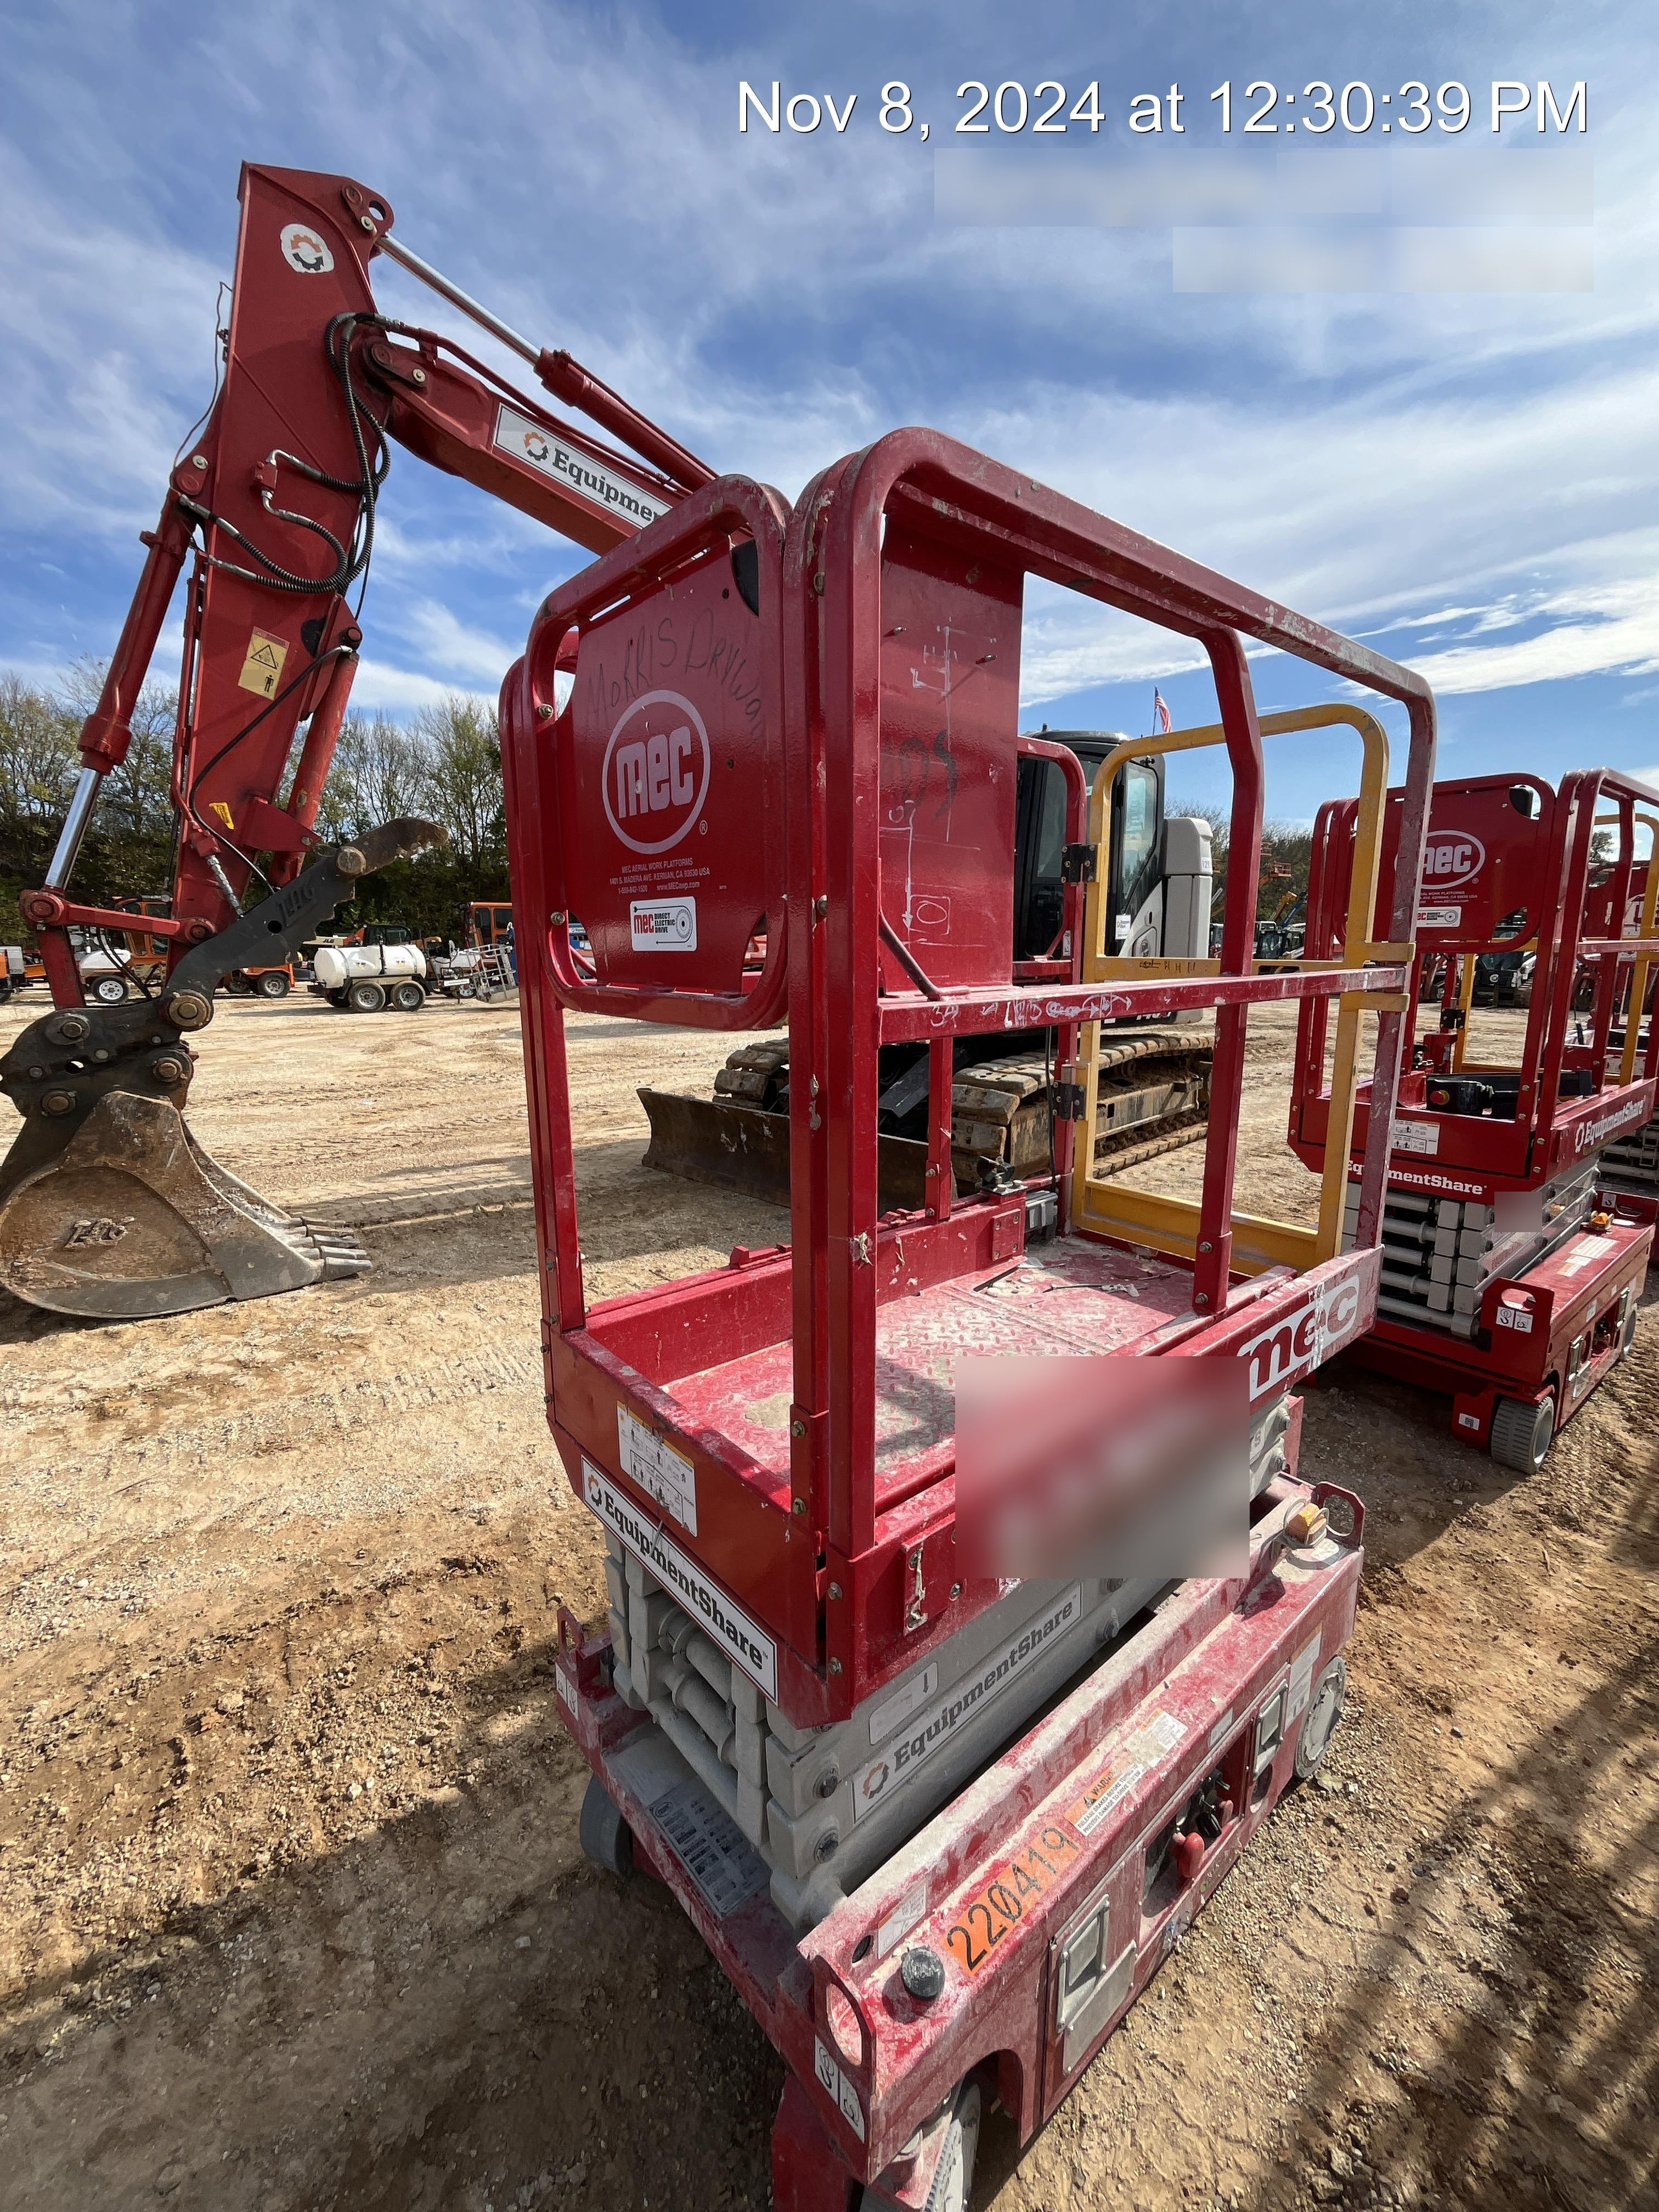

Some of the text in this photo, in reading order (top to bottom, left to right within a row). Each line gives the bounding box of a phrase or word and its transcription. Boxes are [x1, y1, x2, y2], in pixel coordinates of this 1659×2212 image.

[648, 861, 663, 871] WORK
[663, 857, 693, 868] PLATFORMS
[699, 867, 710, 876] USA
[894, 1601, 1073, 1773] EquipmentShare
[1100, 1799, 1115, 1816] DAMAGE
[947, 1827, 1079, 1971] 220419
